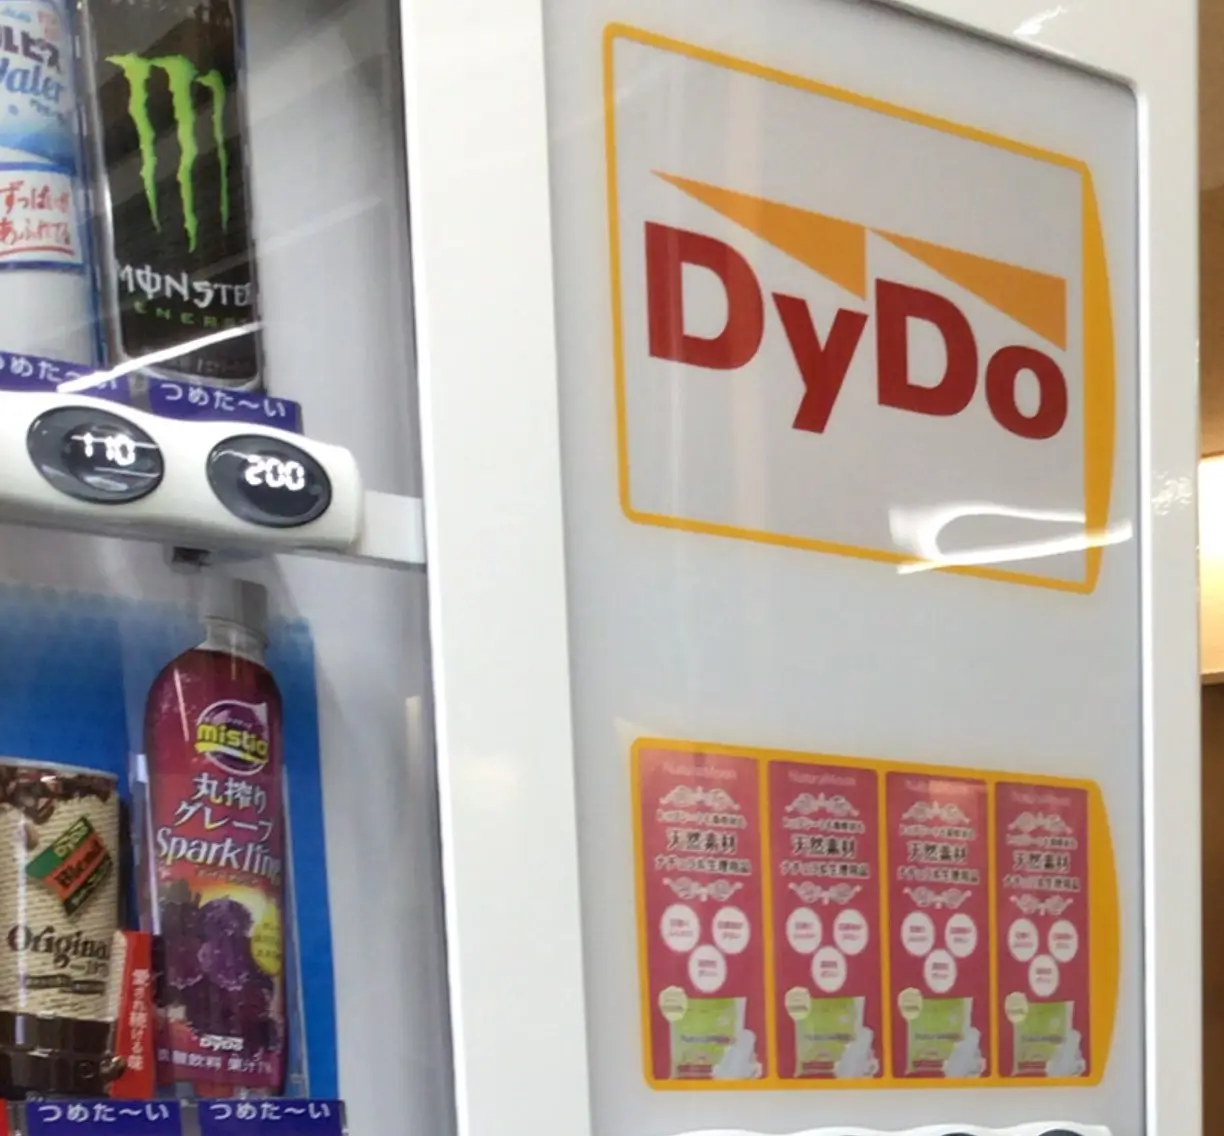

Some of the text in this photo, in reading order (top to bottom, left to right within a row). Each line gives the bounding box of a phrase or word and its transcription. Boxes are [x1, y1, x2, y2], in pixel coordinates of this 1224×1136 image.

[0, 57, 63, 104] ater
[645, 221, 1069, 440] DyDo
[243, 454, 306, 491] 200
